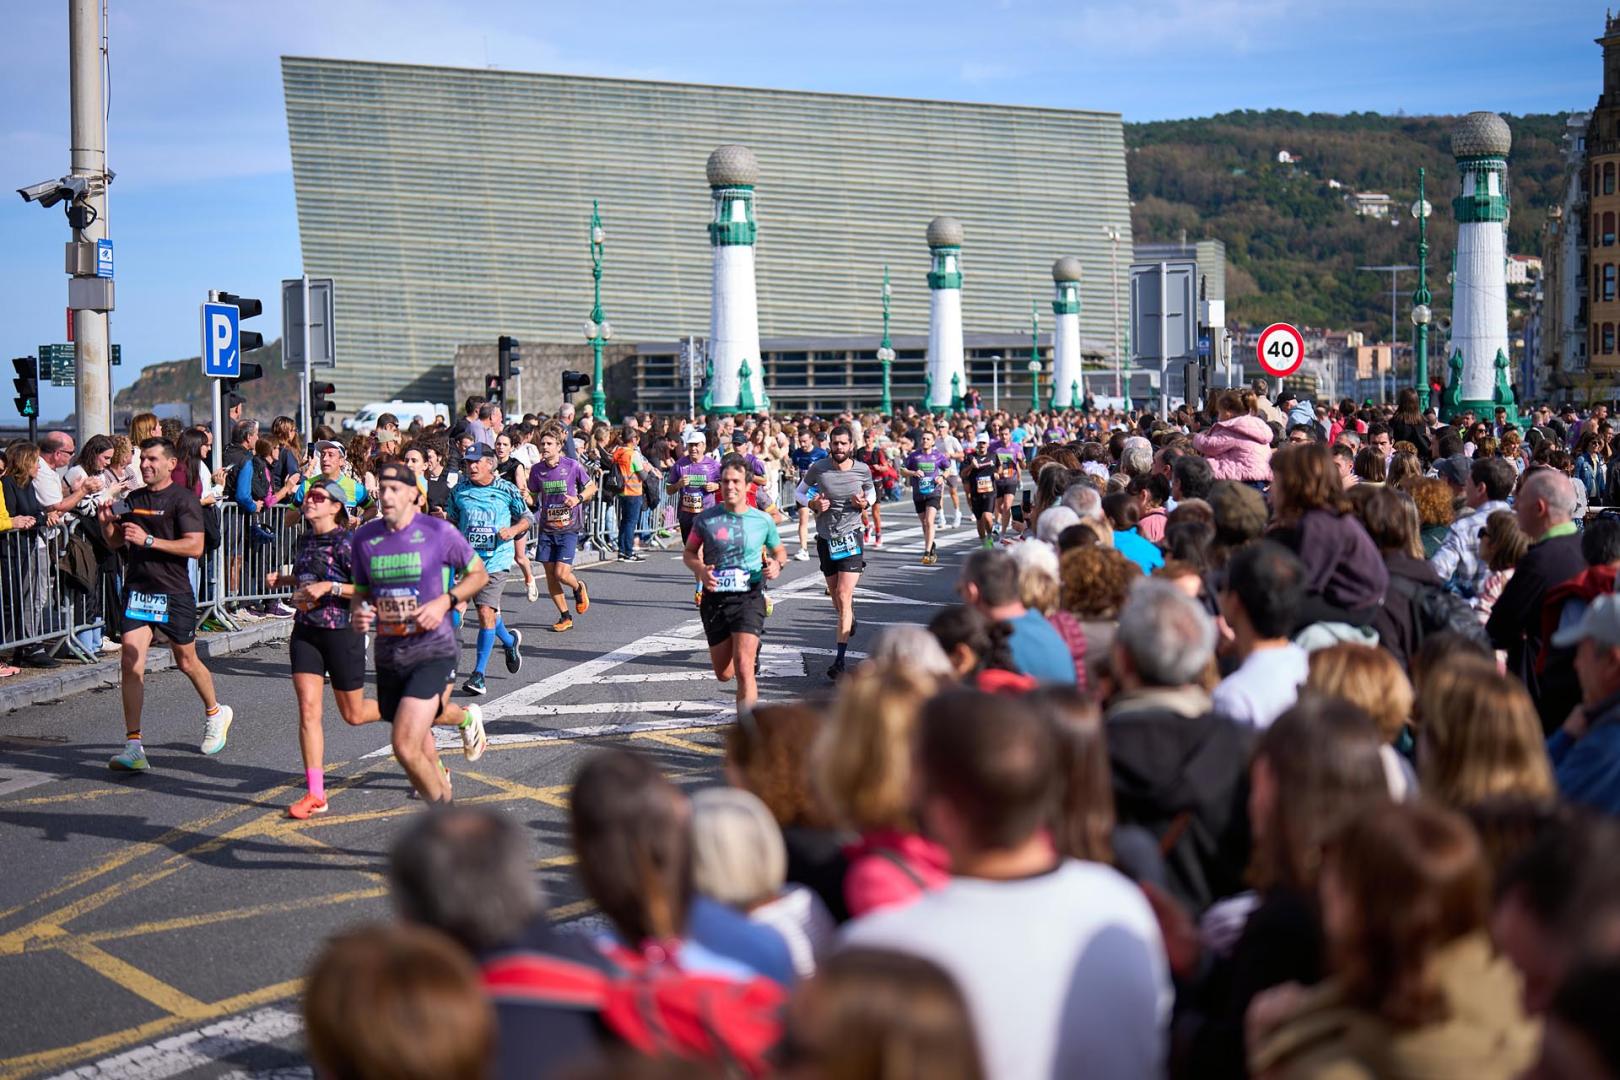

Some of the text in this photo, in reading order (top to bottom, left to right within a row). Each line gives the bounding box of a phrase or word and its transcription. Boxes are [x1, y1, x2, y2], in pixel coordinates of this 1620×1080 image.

[212, 314, 232, 366] P
[1267, 341, 1294, 358] 40
[470, 534, 494, 543] 6291
[133, 591, 167, 605] 10073
